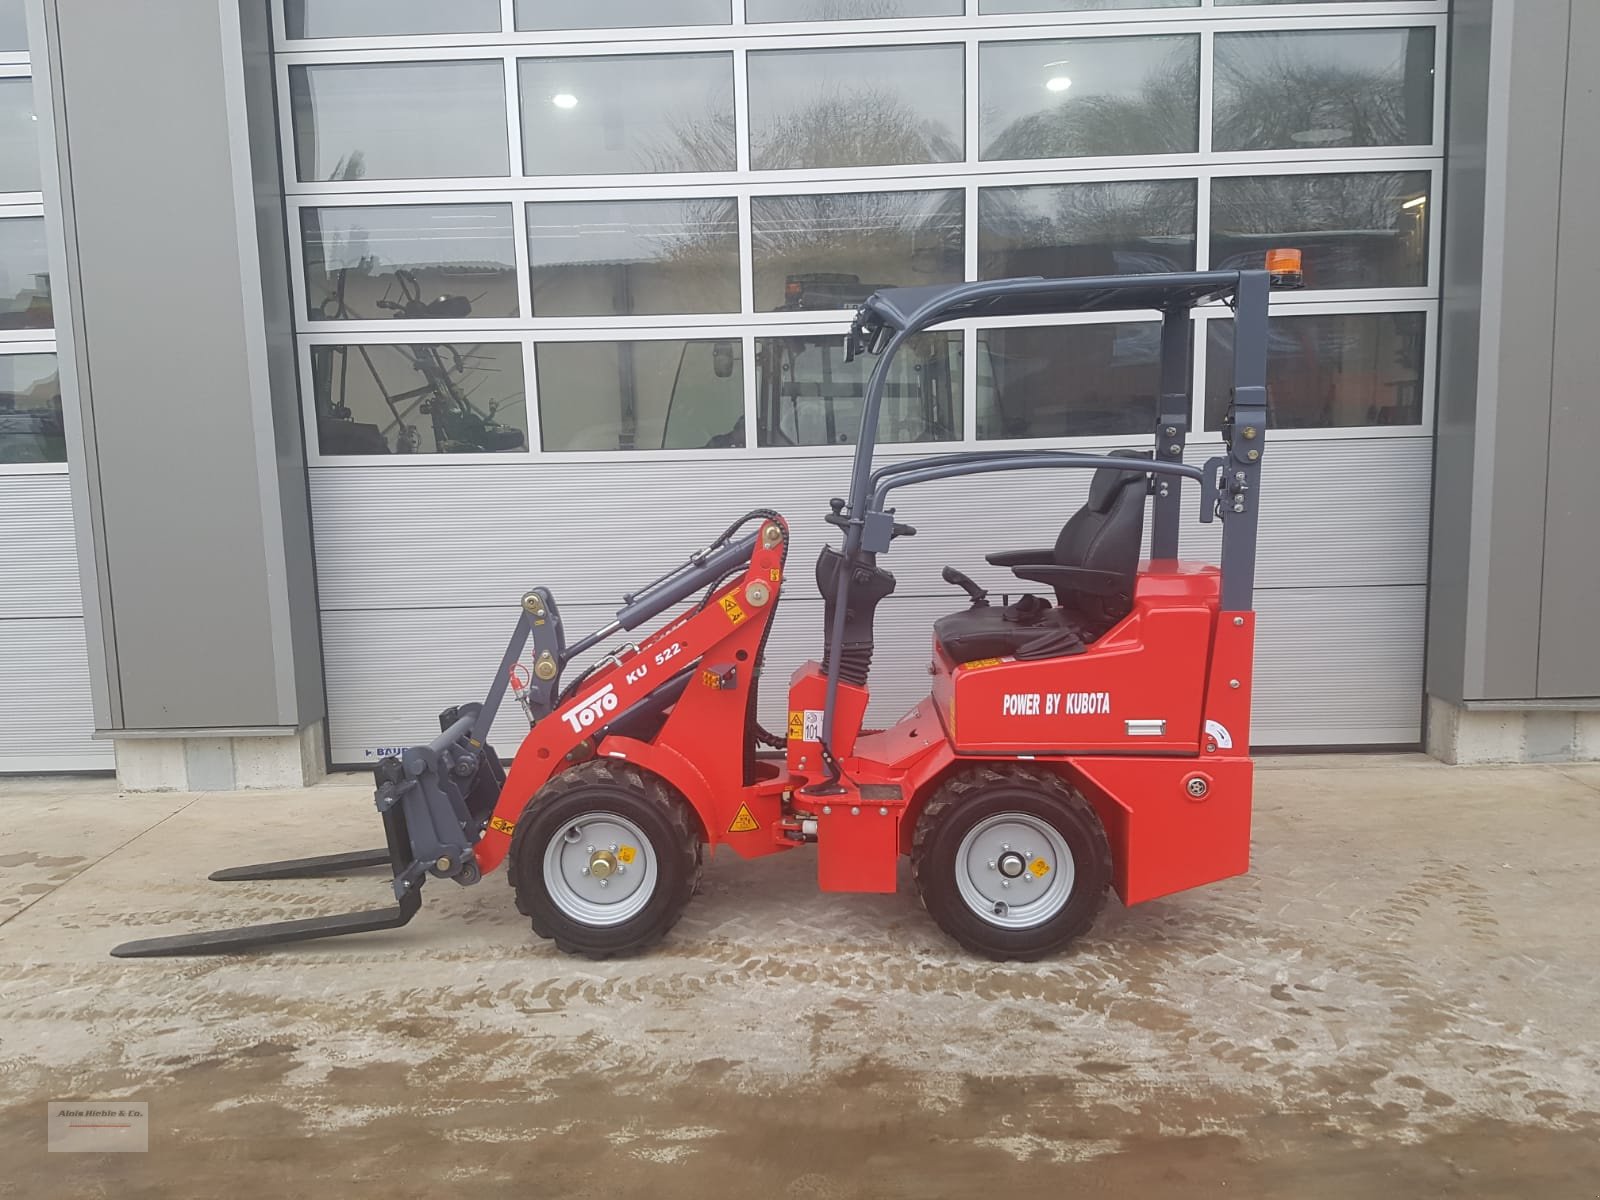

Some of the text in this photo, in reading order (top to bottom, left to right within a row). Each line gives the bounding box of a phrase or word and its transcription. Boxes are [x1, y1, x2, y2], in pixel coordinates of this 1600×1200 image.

[625, 643, 681, 685] KU 522
[1003, 692, 1110, 716] POWER BY KUBOTA
